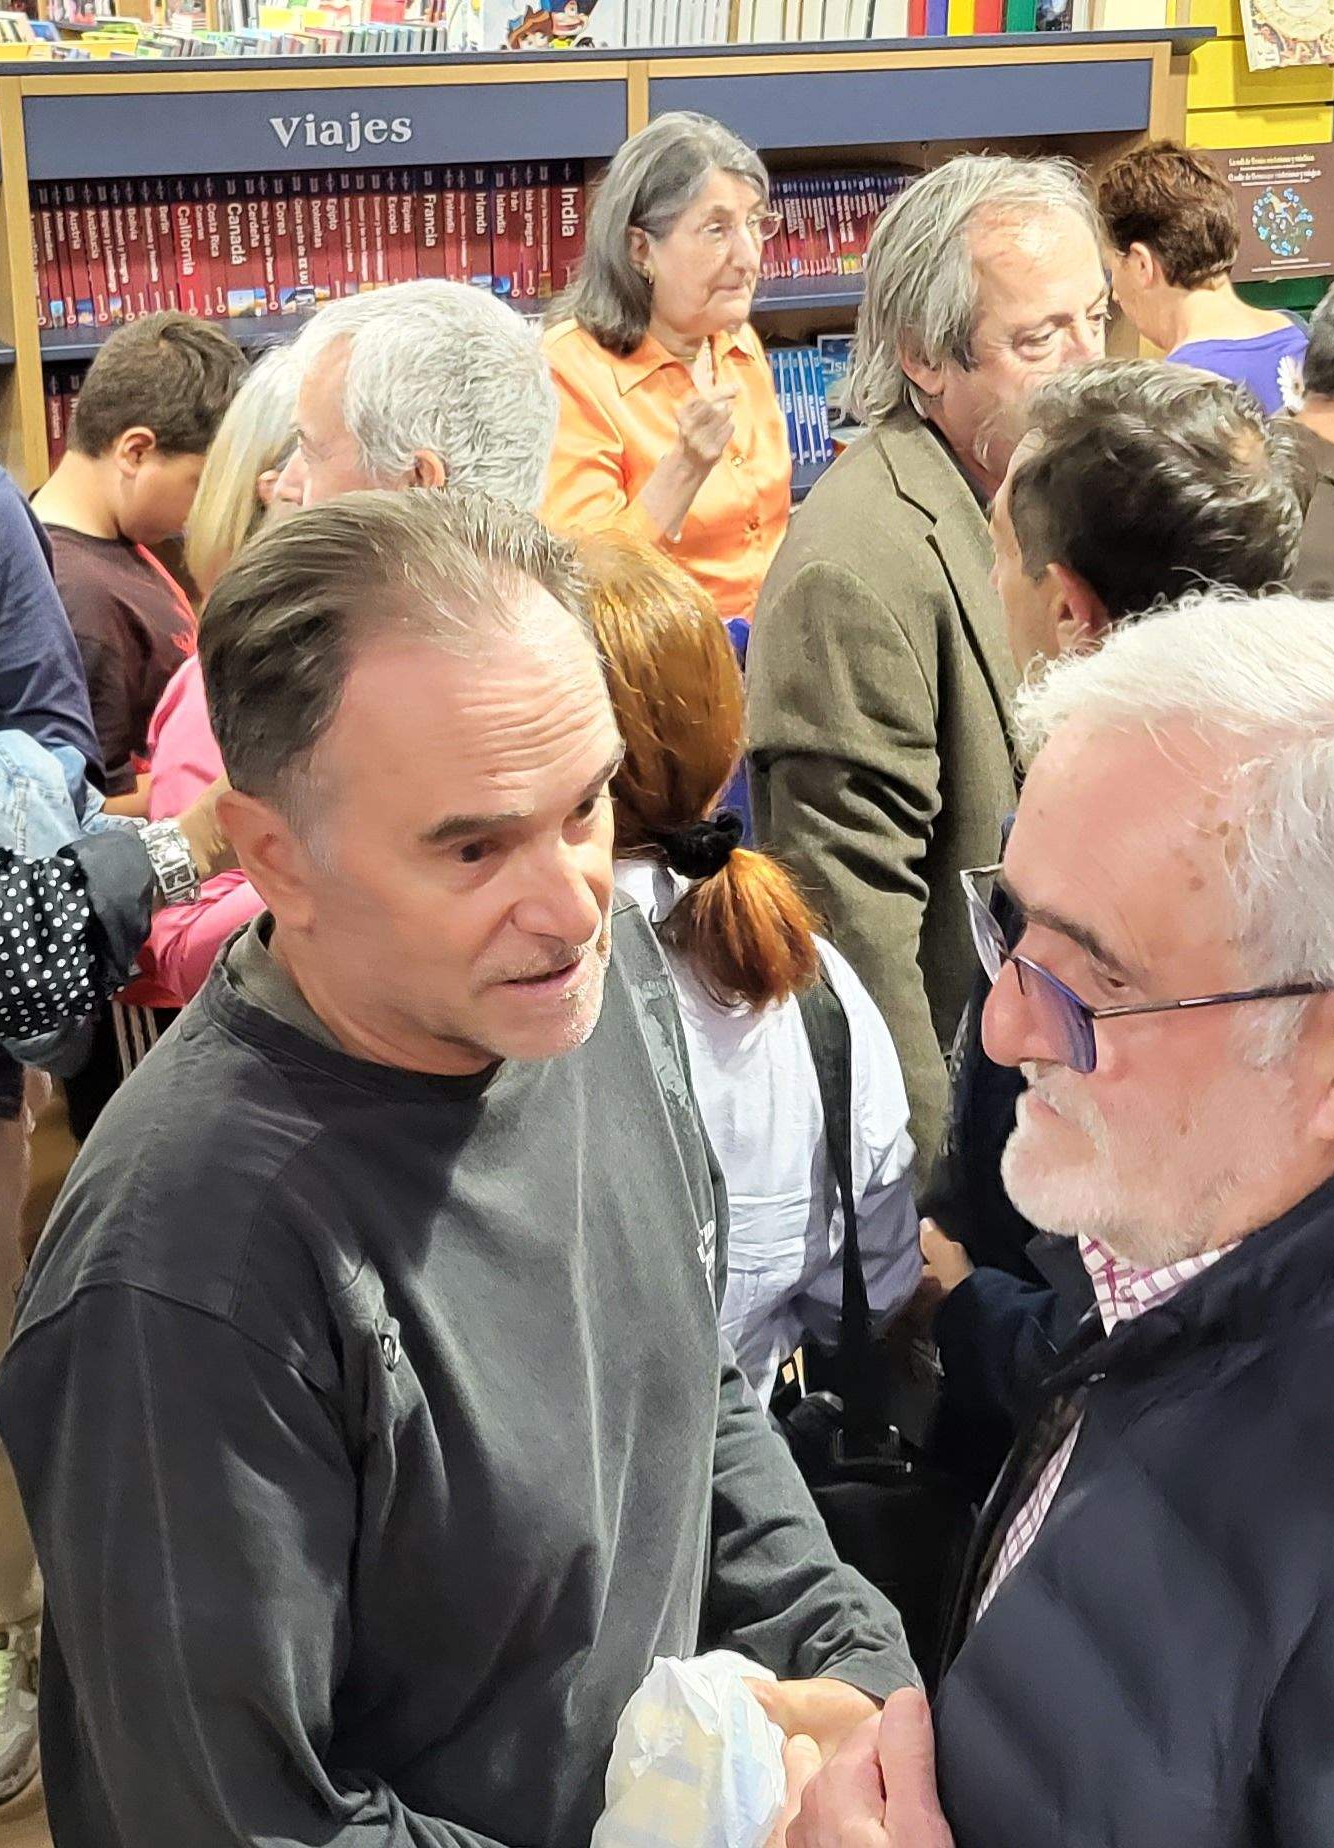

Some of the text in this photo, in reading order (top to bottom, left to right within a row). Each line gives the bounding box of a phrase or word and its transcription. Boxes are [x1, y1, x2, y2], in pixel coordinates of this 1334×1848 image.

[269, 112, 412, 152] Viajes
[69, 211, 81, 250] Austria
[206, 203, 220, 258] Costa Rica
[227, 202, 247, 265] Canadá
[248, 202, 260, 248] Cerdeña
[275, 201, 287, 236] Corea
[312, 200, 322, 248] Dolomitas
[326, 198, 338, 230] Egipto
[387, 196, 397, 234] Escocia
[424, 194, 437, 246] Francia
[475, 193, 487, 234] Irlanda
[496, 194, 506, 234] Islandia
[524, 189, 534, 246] Islas griegas
[561, 187, 579, 237] India
[177, 206, 195, 276] California
